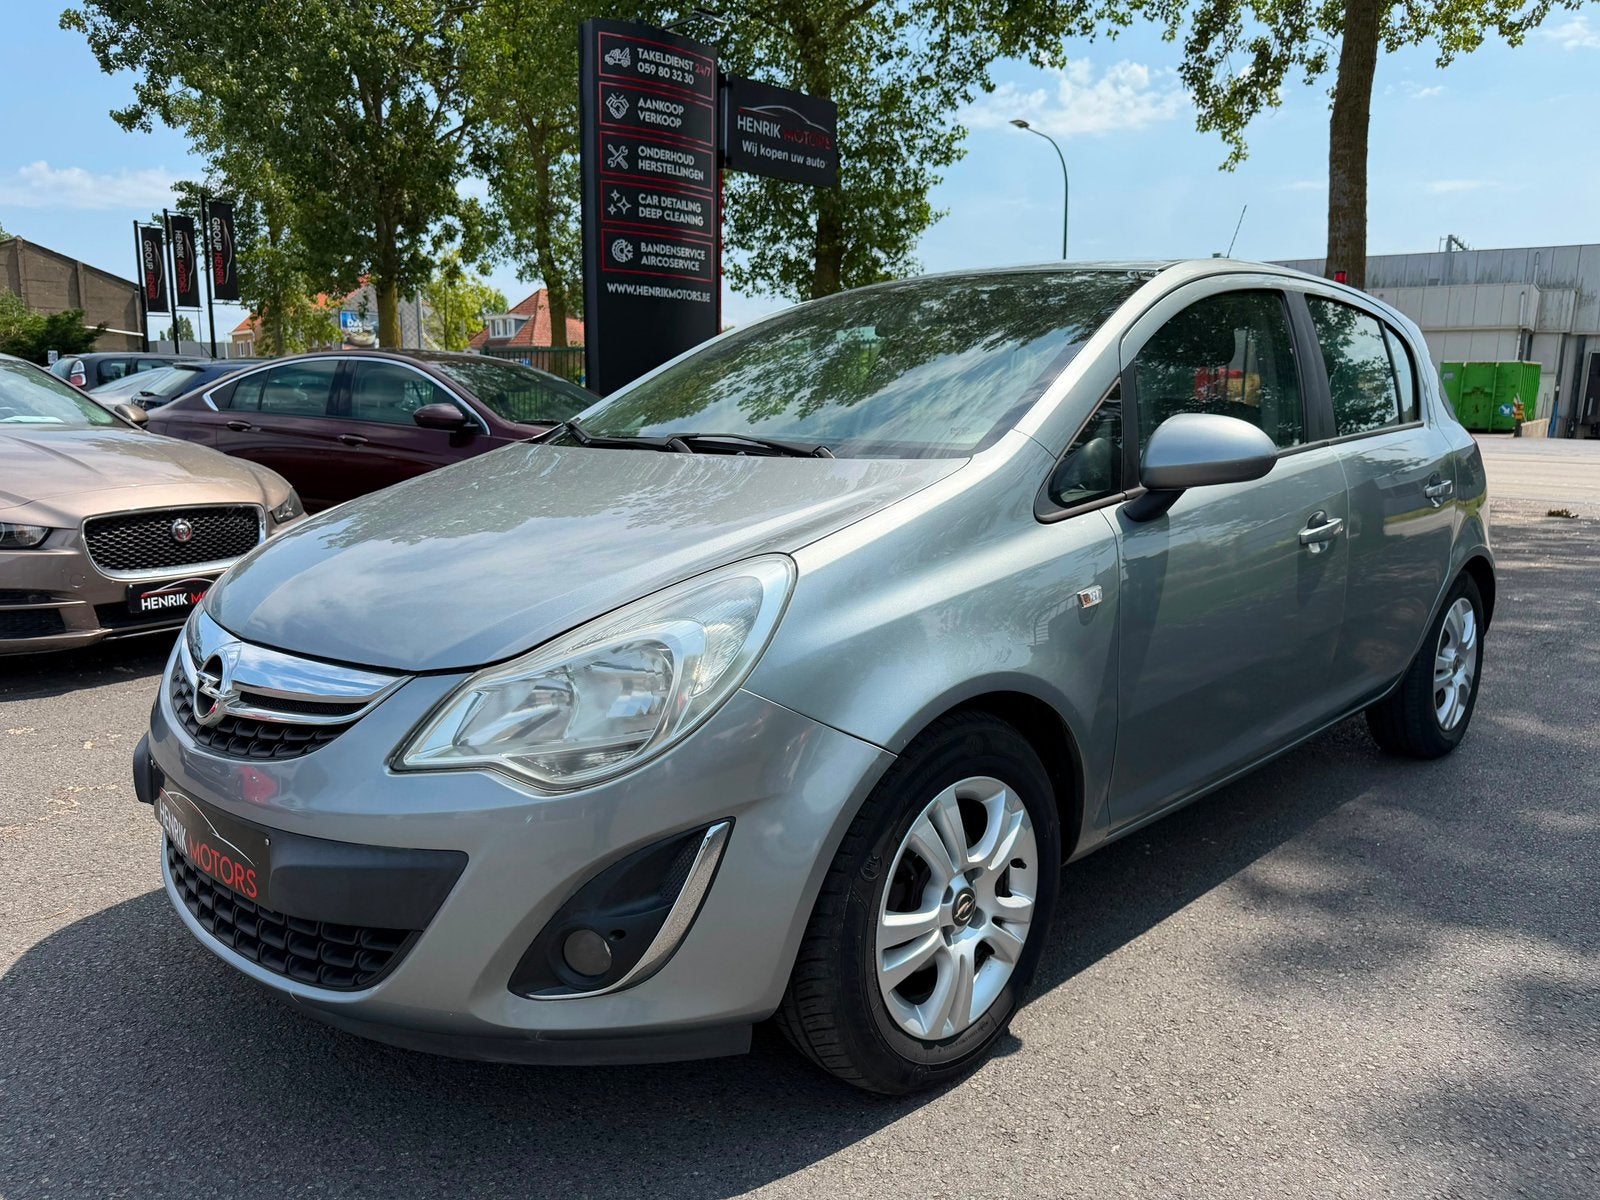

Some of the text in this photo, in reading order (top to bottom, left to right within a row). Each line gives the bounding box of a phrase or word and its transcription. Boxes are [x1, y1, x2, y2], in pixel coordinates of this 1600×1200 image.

[637, 48, 711, 77] TAKELDIENST 24/7
[637, 62, 695, 85] 059 80 32 30
[637, 97, 684, 116] AANKOOP
[637, 110, 682, 128] VERKOOP
[737, 115, 833, 150] HENRIK MOTORS
[637, 146, 695, 165] ONDERHOUD
[742, 140, 825, 169] Wij kopen uw auto
[638, 159, 704, 181] HERSTELLINGEN
[638, 193, 702, 213] CAR DETAILING
[638, 206, 704, 227] DEEP CLEANING
[175, 230, 185, 258] HENRIK
[211, 217, 225, 286] GROUP HENRIK
[640, 242, 706, 260] BANDENSERVICE
[144, 240, 154, 270] GROUP
[641, 255, 700, 271] AIRCOSERVICE
[606, 282, 711, 302] WWW.HENRIKMOTORS.BE
[141, 592, 188, 611] HENRIK
[159, 798, 258, 898] HENRIK MOTORS
